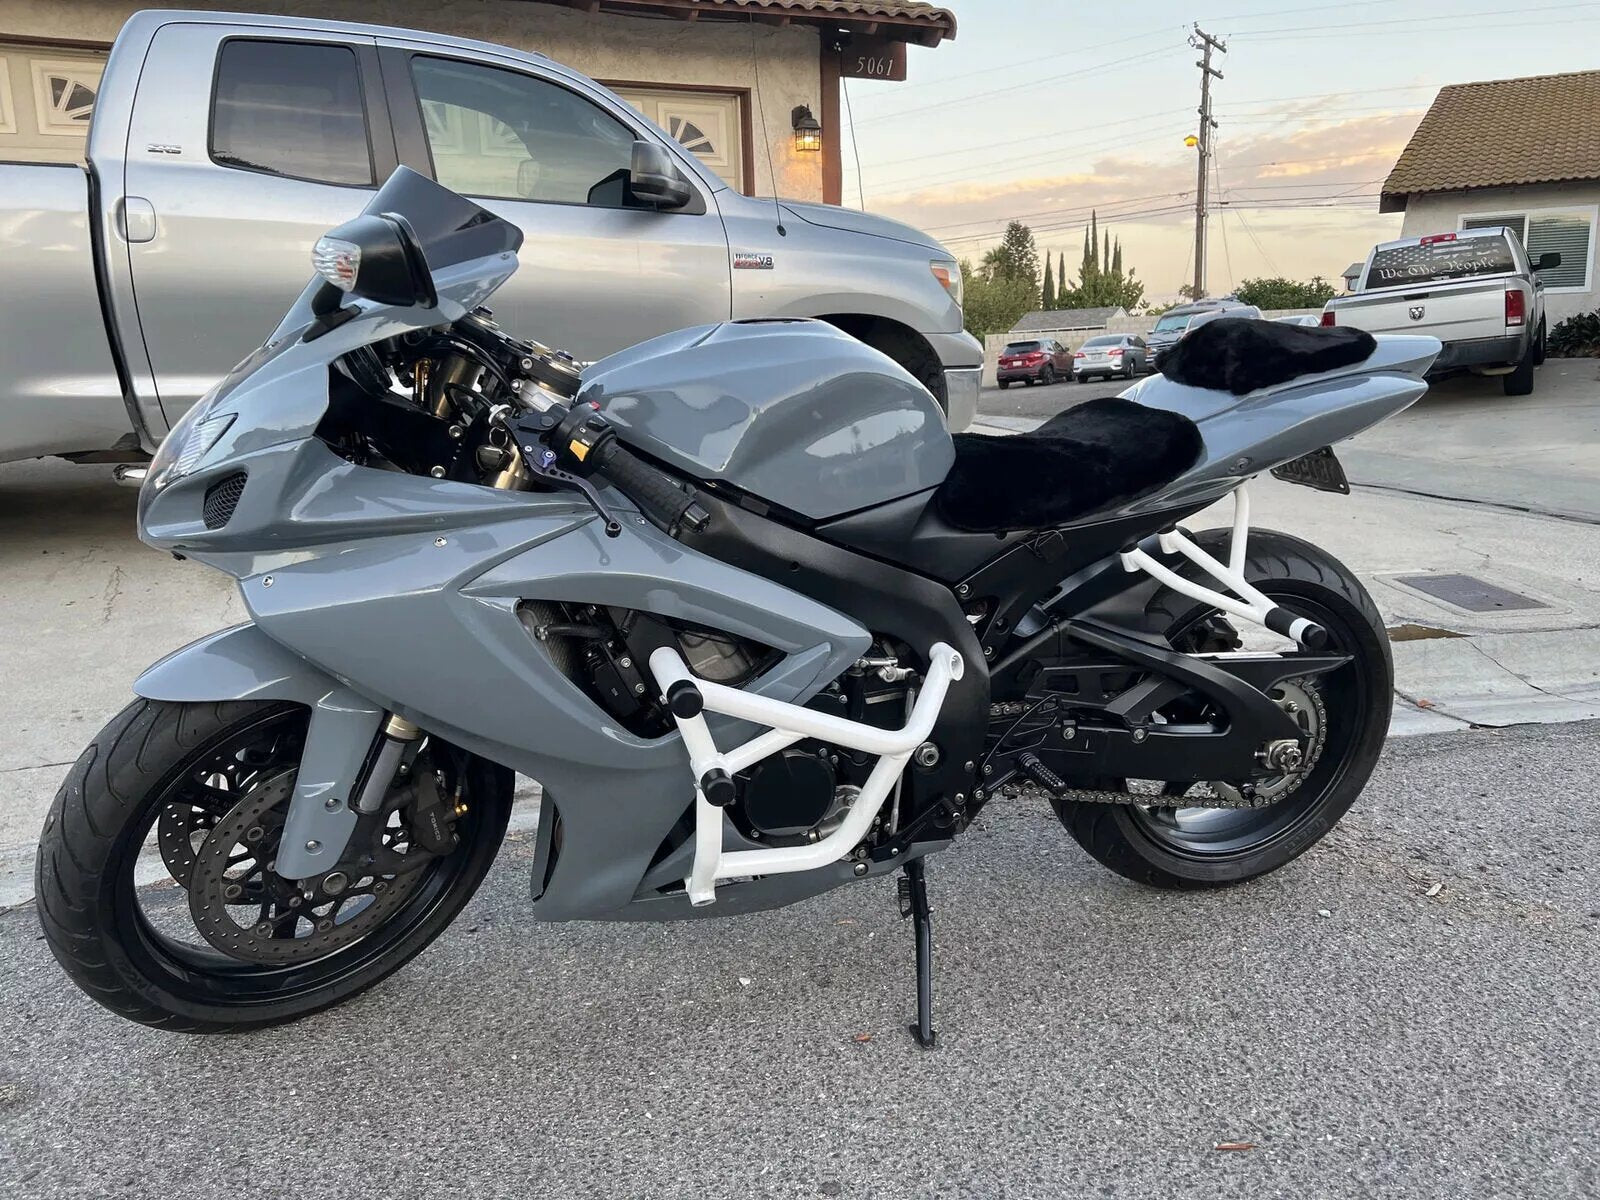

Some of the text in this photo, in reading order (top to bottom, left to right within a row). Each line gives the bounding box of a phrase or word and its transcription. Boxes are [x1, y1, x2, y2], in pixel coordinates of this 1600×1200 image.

[856, 56, 894, 76] 5061
[758, 256, 773, 266] V8
[1379, 256, 1496, 280] We The People
